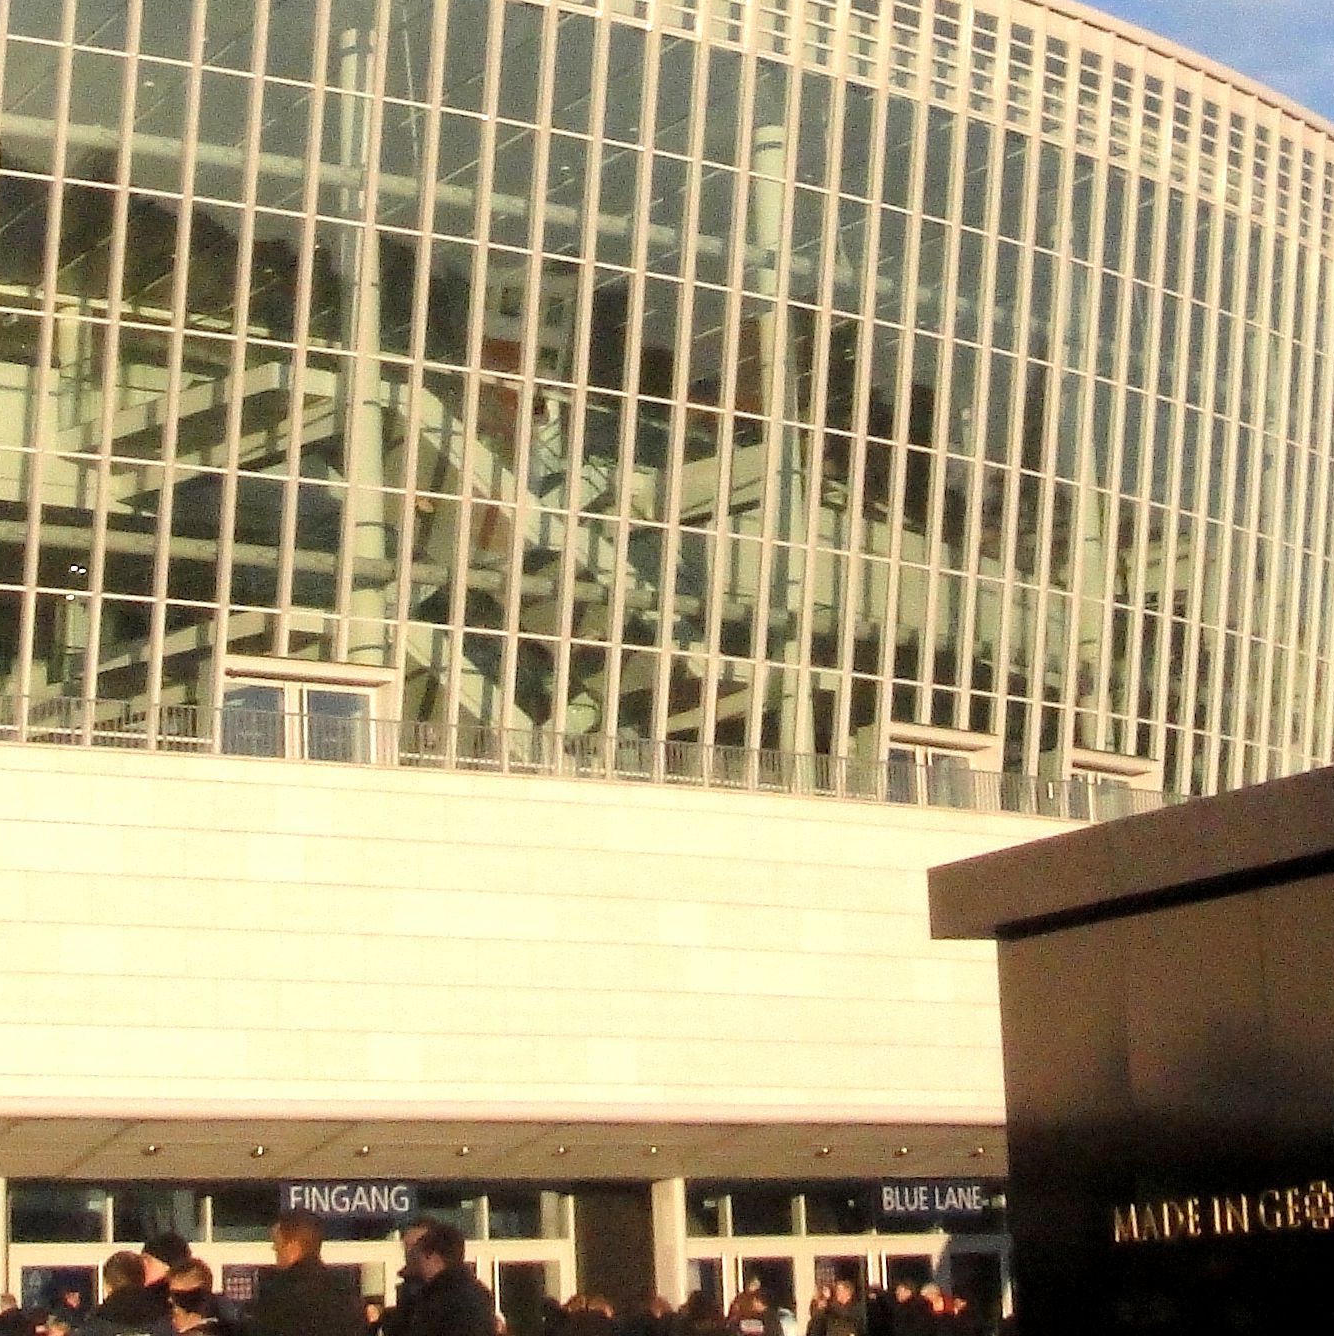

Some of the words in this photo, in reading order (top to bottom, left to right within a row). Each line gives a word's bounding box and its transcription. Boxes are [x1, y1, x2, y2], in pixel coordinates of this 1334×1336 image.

[880, 1184, 930, 1212] BLUE
[933, 1184, 984, 1212] LANE
[1113, 1198, 1202, 1243] MADE
[1212, 1193, 1250, 1235] IN
